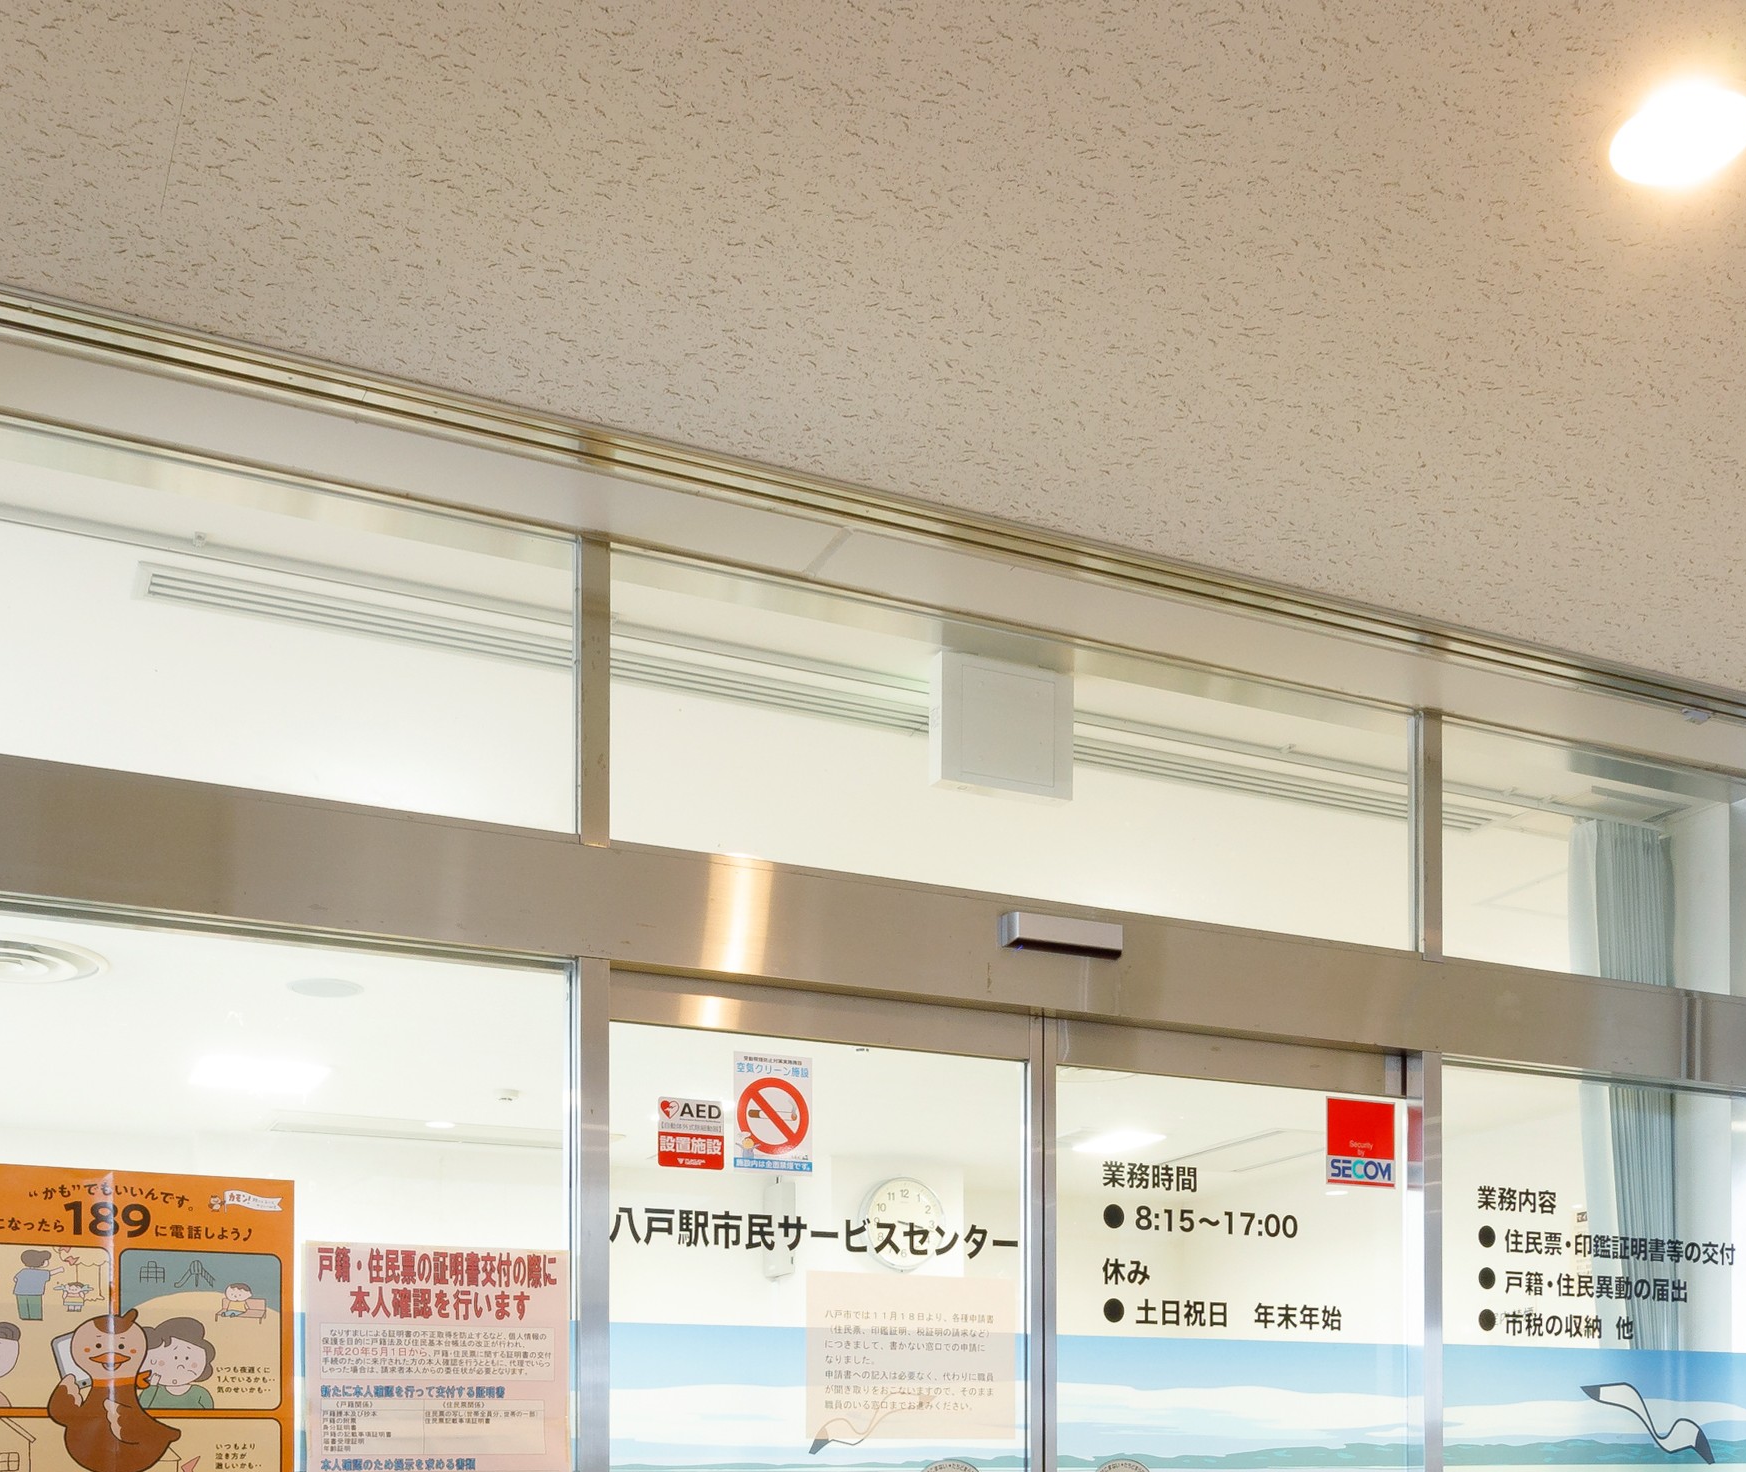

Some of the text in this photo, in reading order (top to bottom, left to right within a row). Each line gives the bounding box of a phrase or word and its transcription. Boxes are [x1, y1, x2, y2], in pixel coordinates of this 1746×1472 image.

[736, 1061, 810, 1078] 空気クリーン施設
[679, 1102, 722, 1119] AED
[659, 1135, 722, 1156] 設置施設
[1349, 1139, 1374, 1151] Security
[1357, 1149, 1366, 1157] by
[1102, 1160, 1198, 1193] 業務時間
[1331, 1158, 1392, 1181] SECOM
[1477, 1185, 1557, 1215] 業務内容
[609, 1206, 1019, 1260] 八戸駅市民サービスセンター
[1504, 1228, 1736, 1266] 住民票・印鑑証明書等の交付
[317, 1245, 558, 1289] 戸籍・住民票の証明書交付の際に
[1102, 1257, 1151, 1286] 休み
[1505, 1270, 1688, 1303] 戸籍・住民異動の届出
[350, 1286, 531, 1321] 本人確認を行います
[1135, 1299, 1342, 1332] 土日祝日 年末年始
[1504, 1311, 1602, 1340] 市税の収納
[1616, 1316, 1635, 1341] 他
[825, 1354, 875, 1366] なりました。
[320, 1385, 506, 1399] 新たに本人確認を行って交付する証明書
[215, 1443, 256, 1451] いつもより
